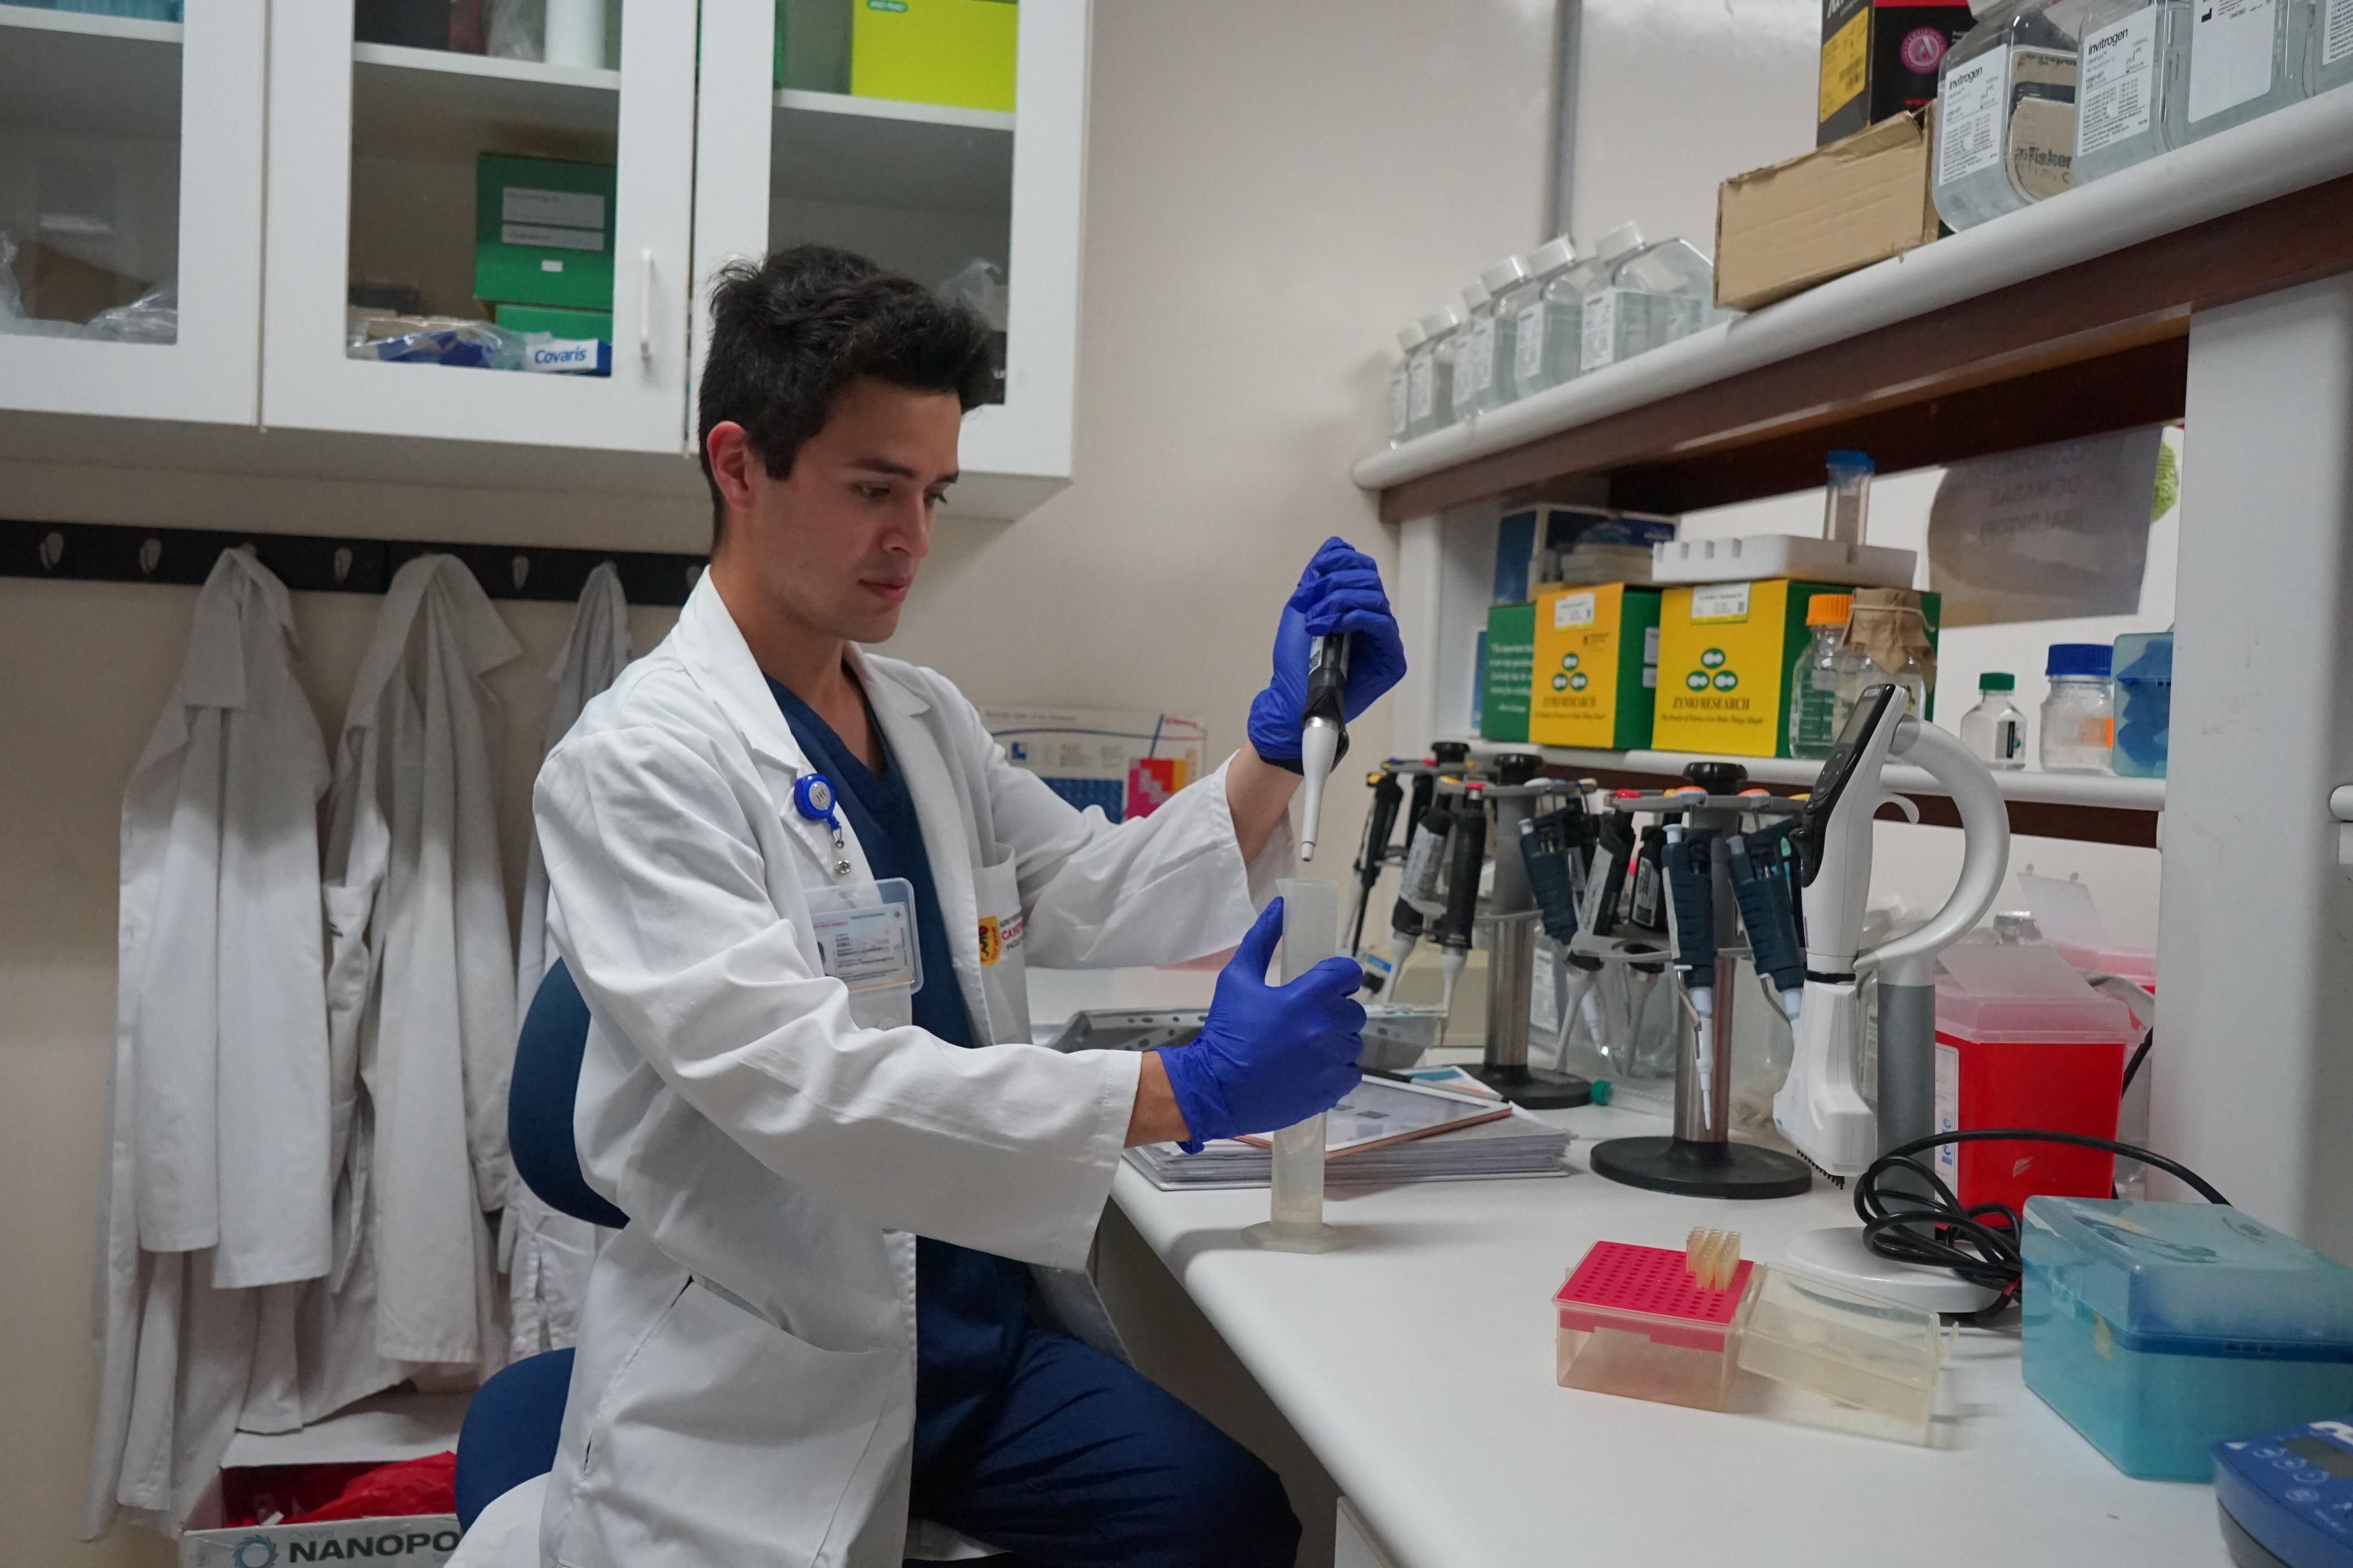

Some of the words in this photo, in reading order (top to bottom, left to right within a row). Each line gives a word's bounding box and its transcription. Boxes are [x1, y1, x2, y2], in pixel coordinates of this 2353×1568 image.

[2088, 28, 2128, 55] invitrogen
[1949, 66, 1983, 90] invitrogen
[535, 347, 587, 365] Covaris
[1673, 696, 1698, 708] ZYMO
[1700, 697, 1750, 710] RESEARCH
